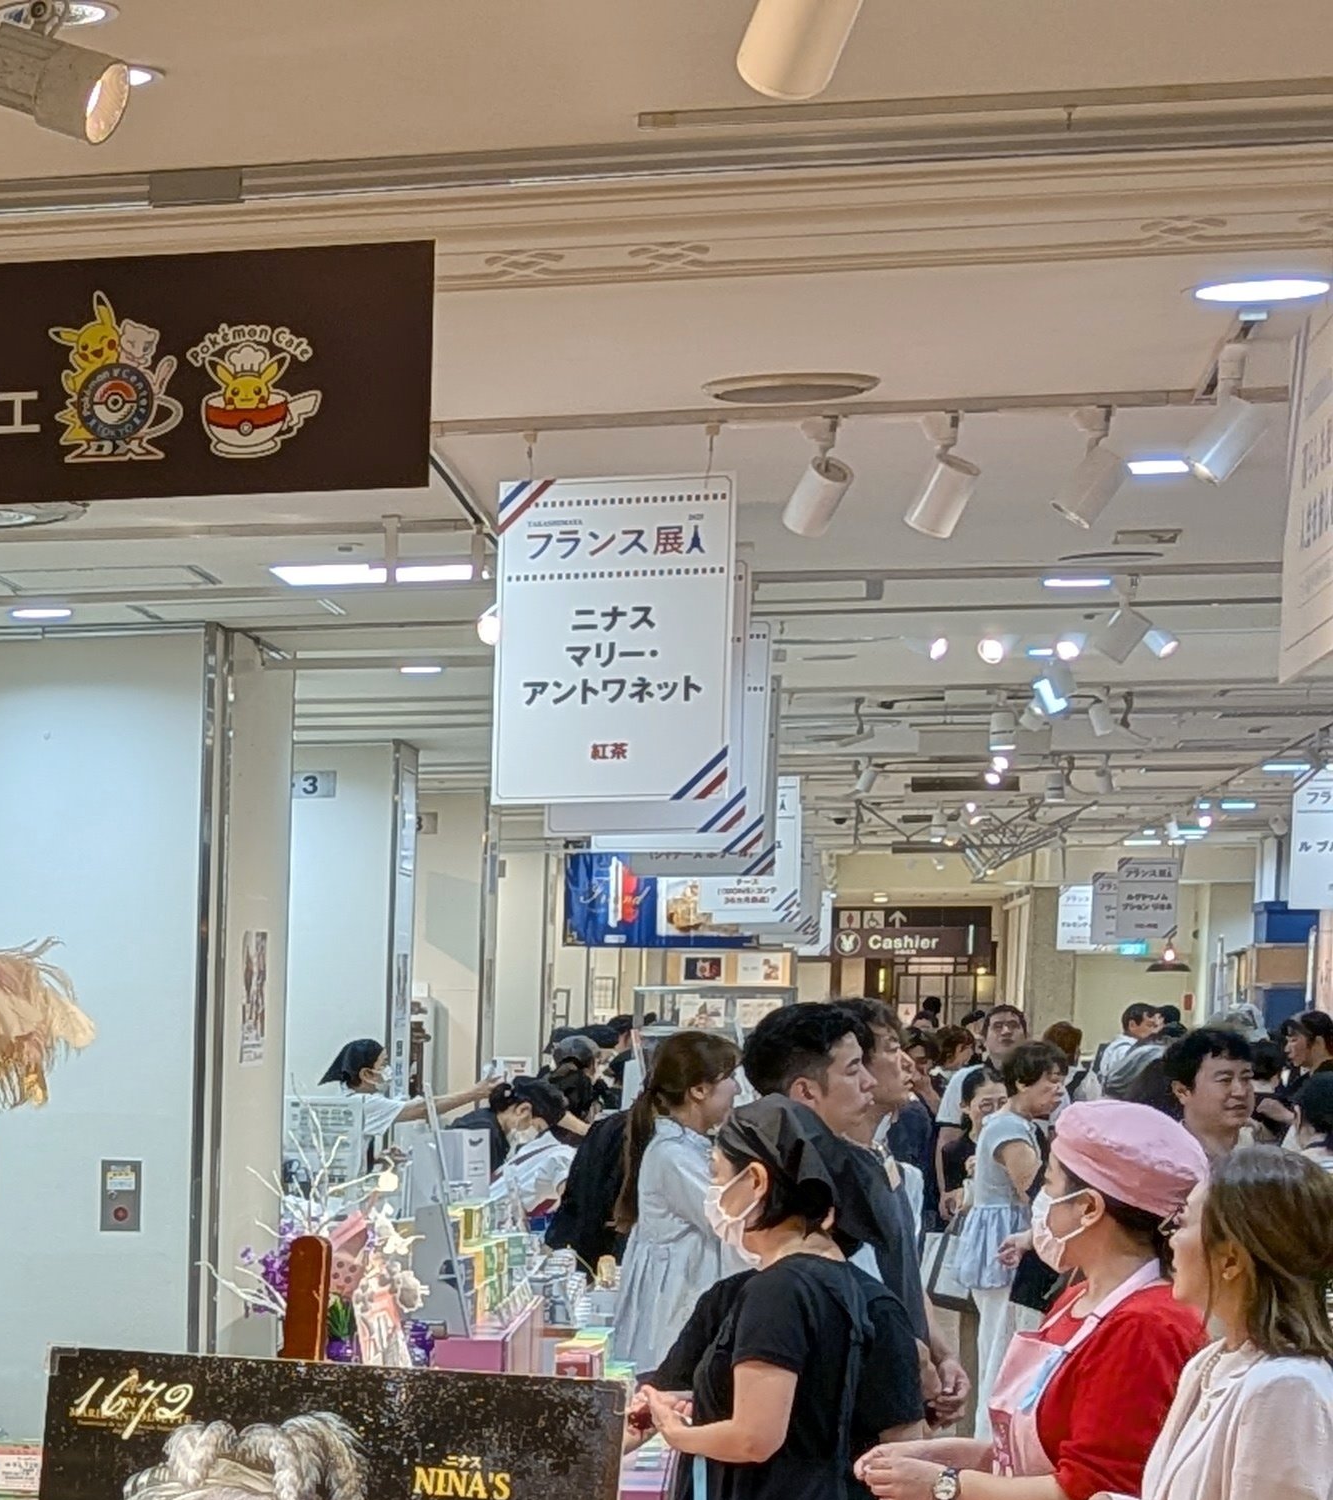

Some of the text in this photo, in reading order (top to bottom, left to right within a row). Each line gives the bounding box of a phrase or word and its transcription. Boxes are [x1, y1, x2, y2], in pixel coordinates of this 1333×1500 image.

[272, 326, 313, 362] Cafe
[527, 525, 684, 560] フランス展
[571, 605, 656, 631] ニナス
[566, 641, 659, 667] マリー・
[523, 674, 703, 706] アントワネット
[590, 741, 628, 760] 紅茶
[868, 934, 939, 950] Cashier
[444, 1455, 482, 1469] ニナス
[413, 1466, 511, 1500] NINA'S
